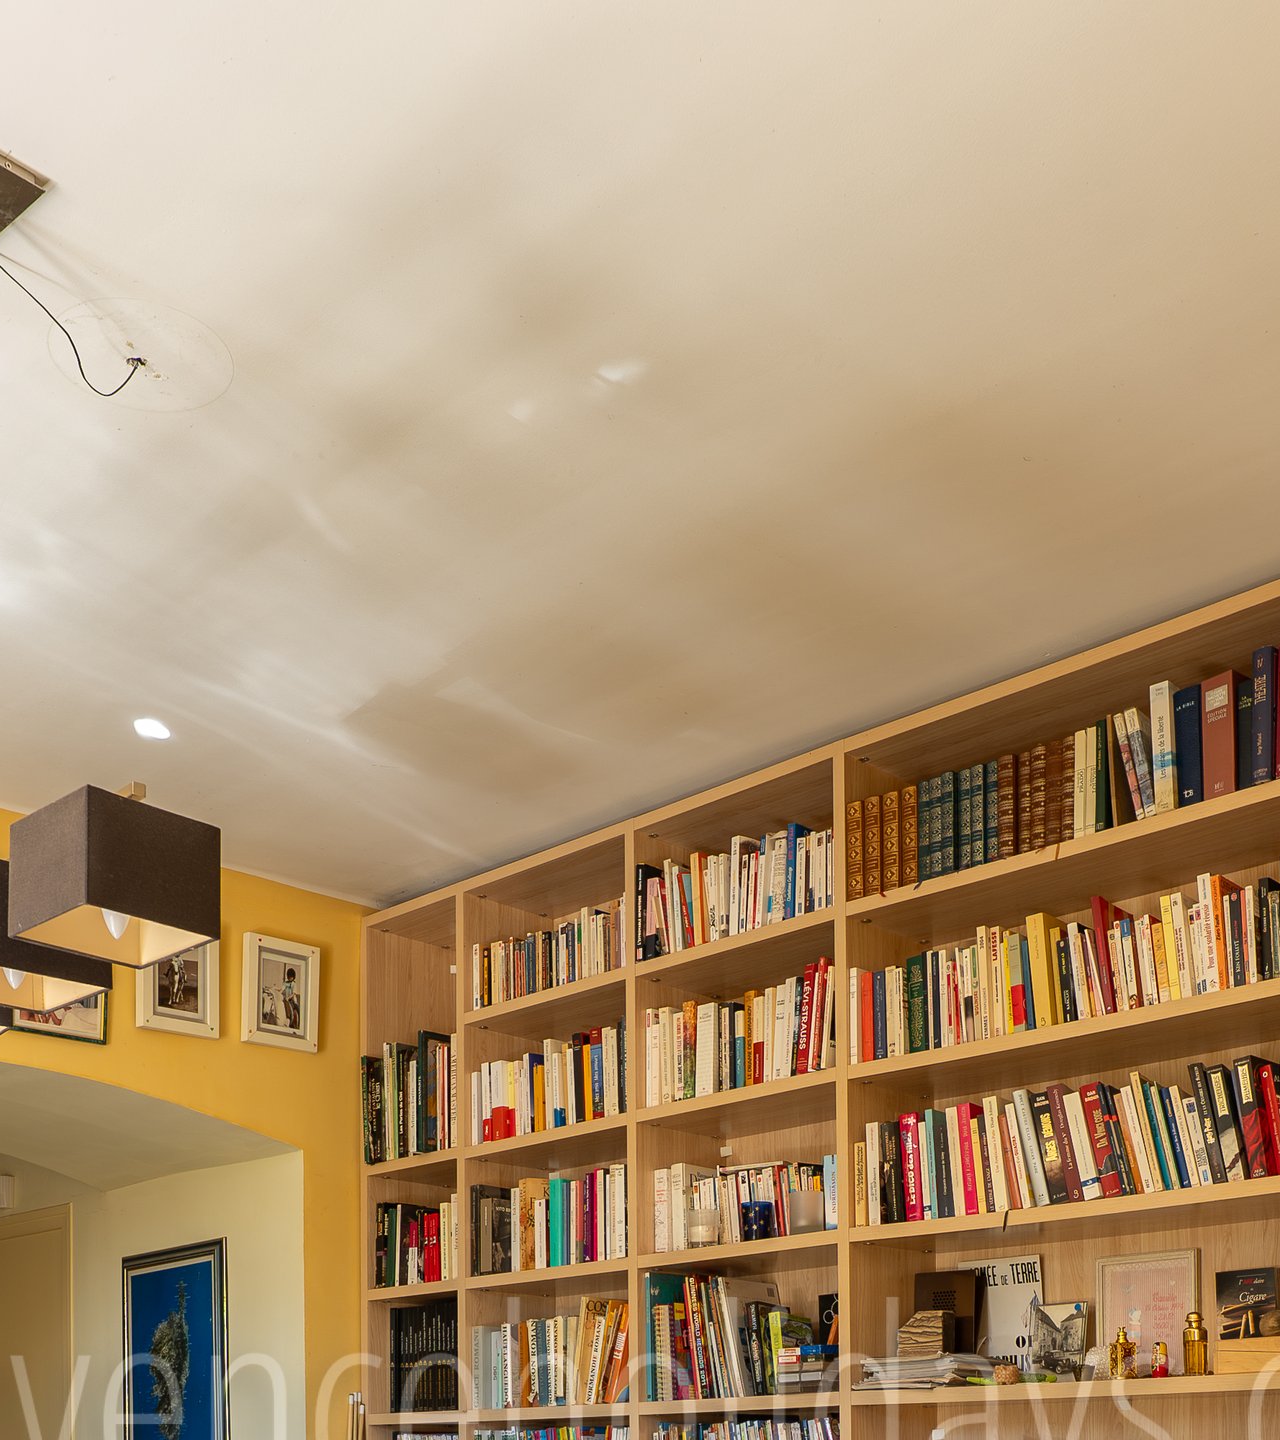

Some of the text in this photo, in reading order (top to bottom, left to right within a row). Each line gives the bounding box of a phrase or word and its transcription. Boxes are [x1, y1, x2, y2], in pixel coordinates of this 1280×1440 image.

[798, 980, 812, 1050] LÉVI-STRAUSS
[1240, 1067, 1251, 1102] RUMEURS
[1000, 1275, 1008, 1286] DE
[1009, 1261, 1040, 1285] TERRE
[689, 1277, 698, 1312] GUINNESS
[1239, 1291, 1267, 1305] Cigare
[693, 1312, 701, 1337] WORLD
[585, 1319, 602, 1403] NORMANDIE ROMANE
[696, 1337, 706, 1369] RECORDS
